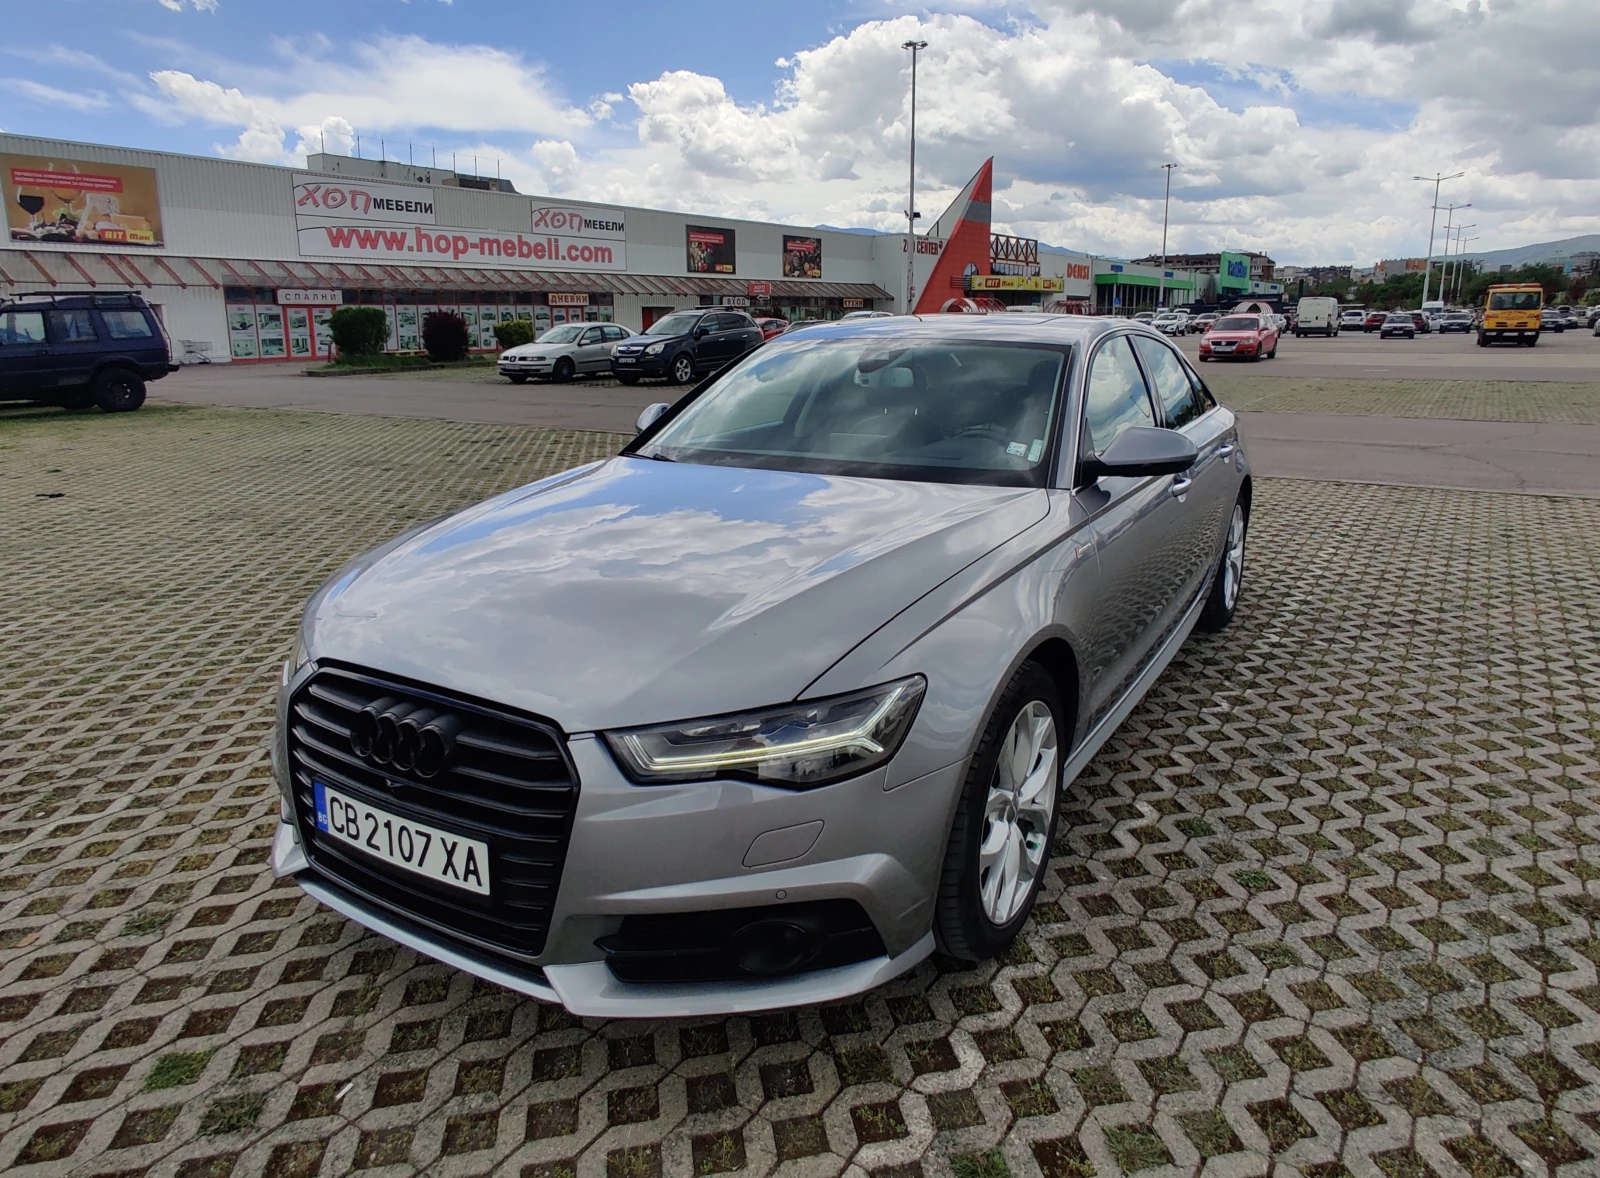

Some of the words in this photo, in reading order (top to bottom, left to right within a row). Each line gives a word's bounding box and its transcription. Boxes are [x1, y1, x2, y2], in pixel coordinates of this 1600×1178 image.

[297, 182, 372, 214] ХОП
[373, 198, 434, 215] МЕБЕЛИ
[534, 208, 584, 233] ХОП
[584, 218, 625, 233] МЕБЕЛИ
[105, 231, 124, 240] HIT
[326, 226, 613, 265] www.hop-mebeli.com
[917, 240, 939, 256] CENTER
[1067, 262, 1090, 280] DENSI
[986, 279, 999, 287] HIT
[285, 293, 337, 302] СПАЛНИ
[550, 294, 588, 305] ДНЕВНИ
[727, 297, 746, 306] ВХОД
[844, 299, 863, 307] КУХНИ
[318, 812, 328, 825] BG
[329, 795, 361, 841] CB
[364, 813, 432, 868] 2107
[440, 836, 483, 887] XA
